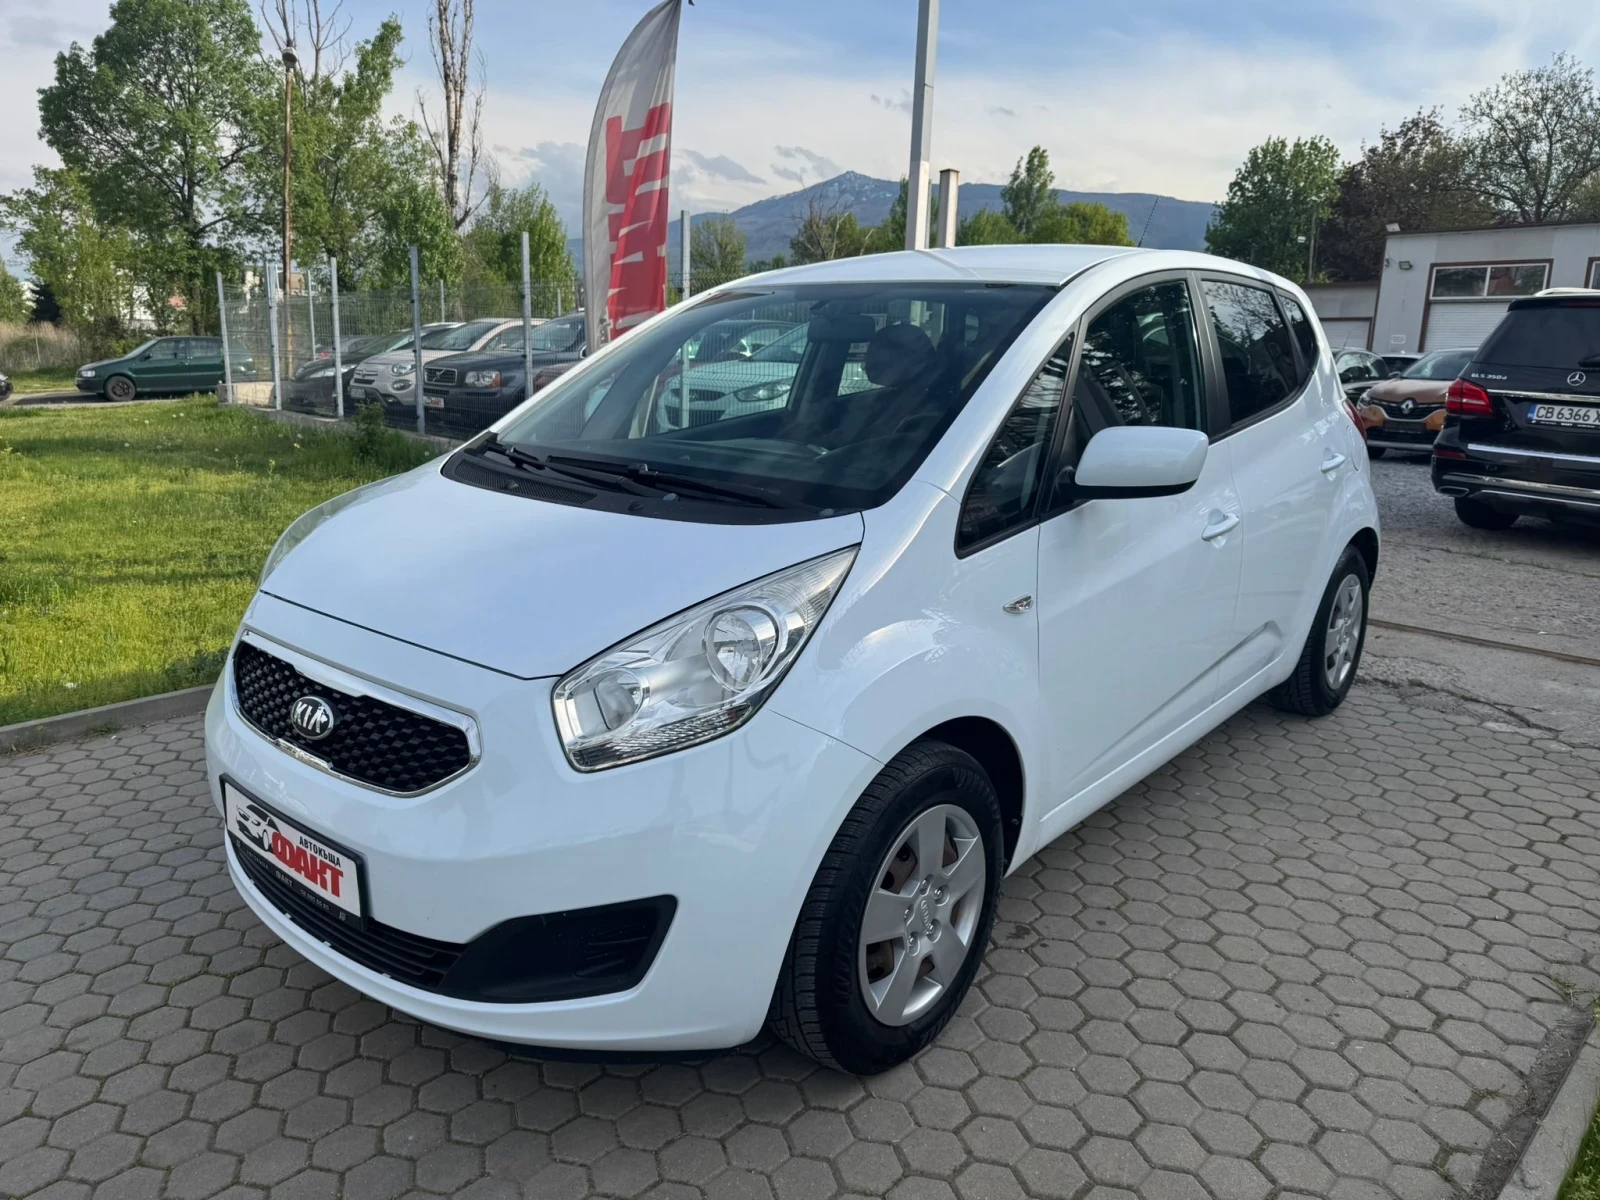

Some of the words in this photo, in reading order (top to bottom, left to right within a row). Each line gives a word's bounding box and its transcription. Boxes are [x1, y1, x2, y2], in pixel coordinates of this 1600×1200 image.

[1536, 406, 1555, 419] CB
[1556, 407, 1591, 422] 6366
[294, 701, 328, 734] KIA
[271, 831, 344, 898] ФАКТ
[299, 835, 342, 868] АВТОКЪЩА
[275, 870, 293, 887] ФАКТ
